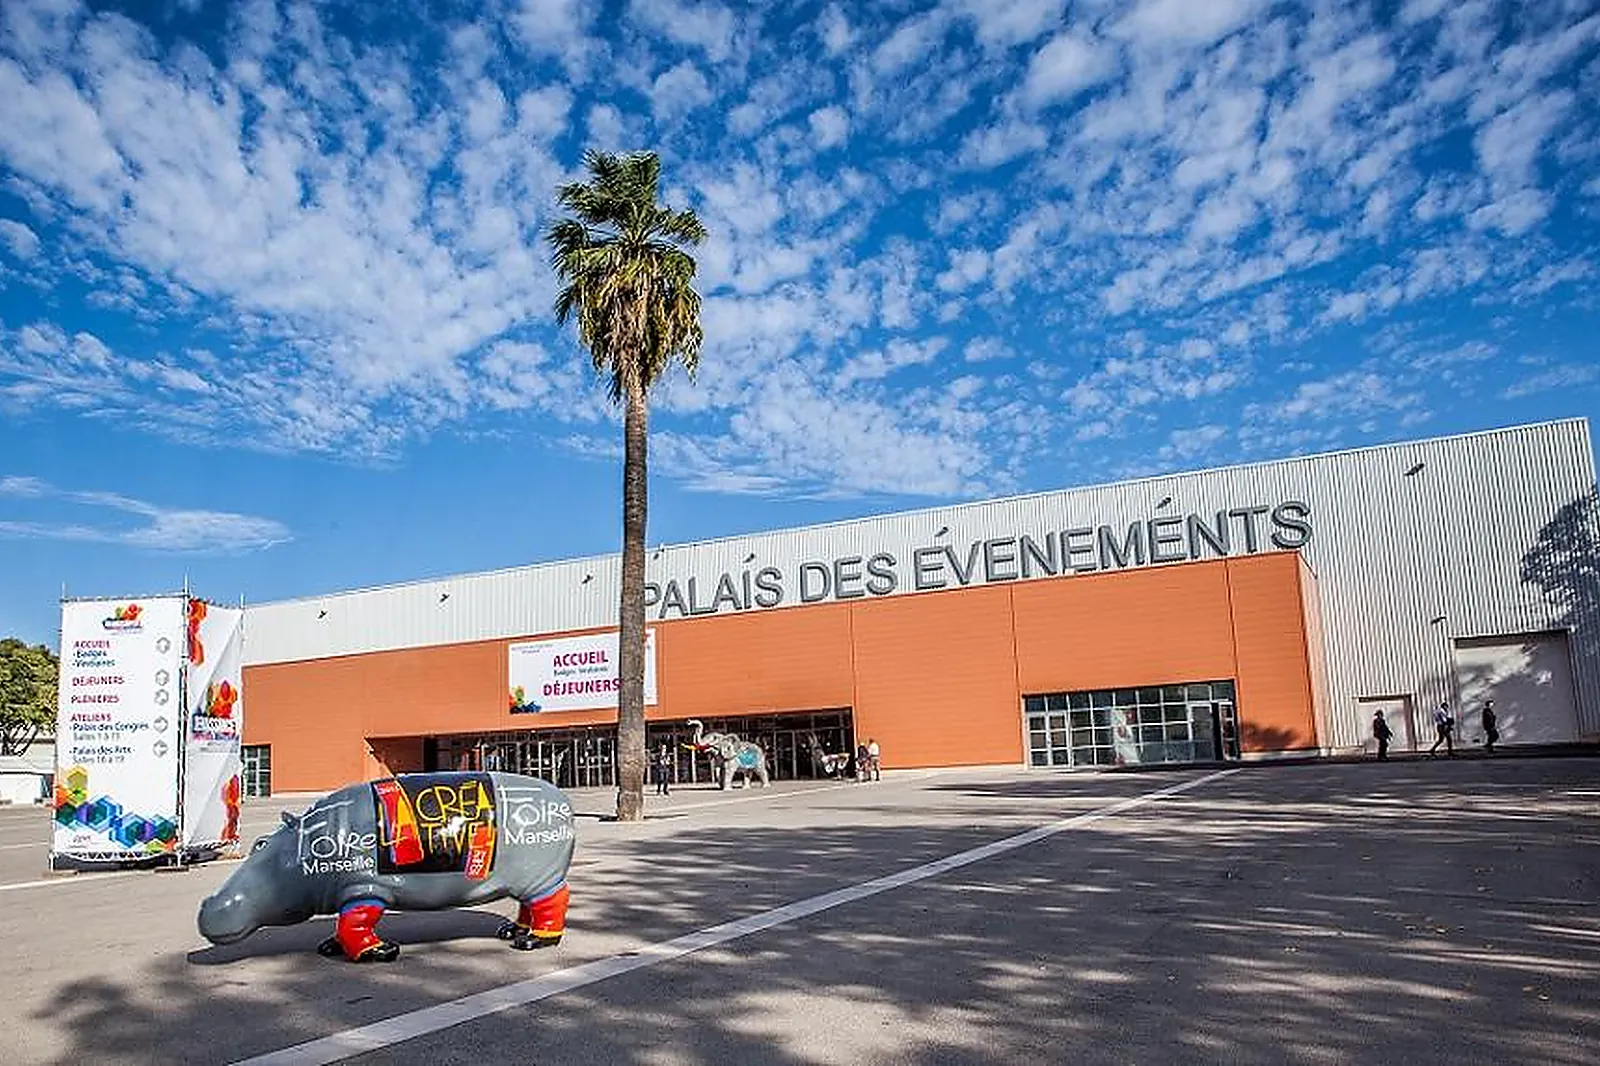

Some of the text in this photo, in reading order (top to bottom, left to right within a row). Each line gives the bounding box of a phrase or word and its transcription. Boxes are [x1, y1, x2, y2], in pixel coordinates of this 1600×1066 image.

[800, 552, 898, 602] DES
[553, 650, 609, 668] ACCUEIL
[543, 678, 621, 696] DÉJEUNERS
